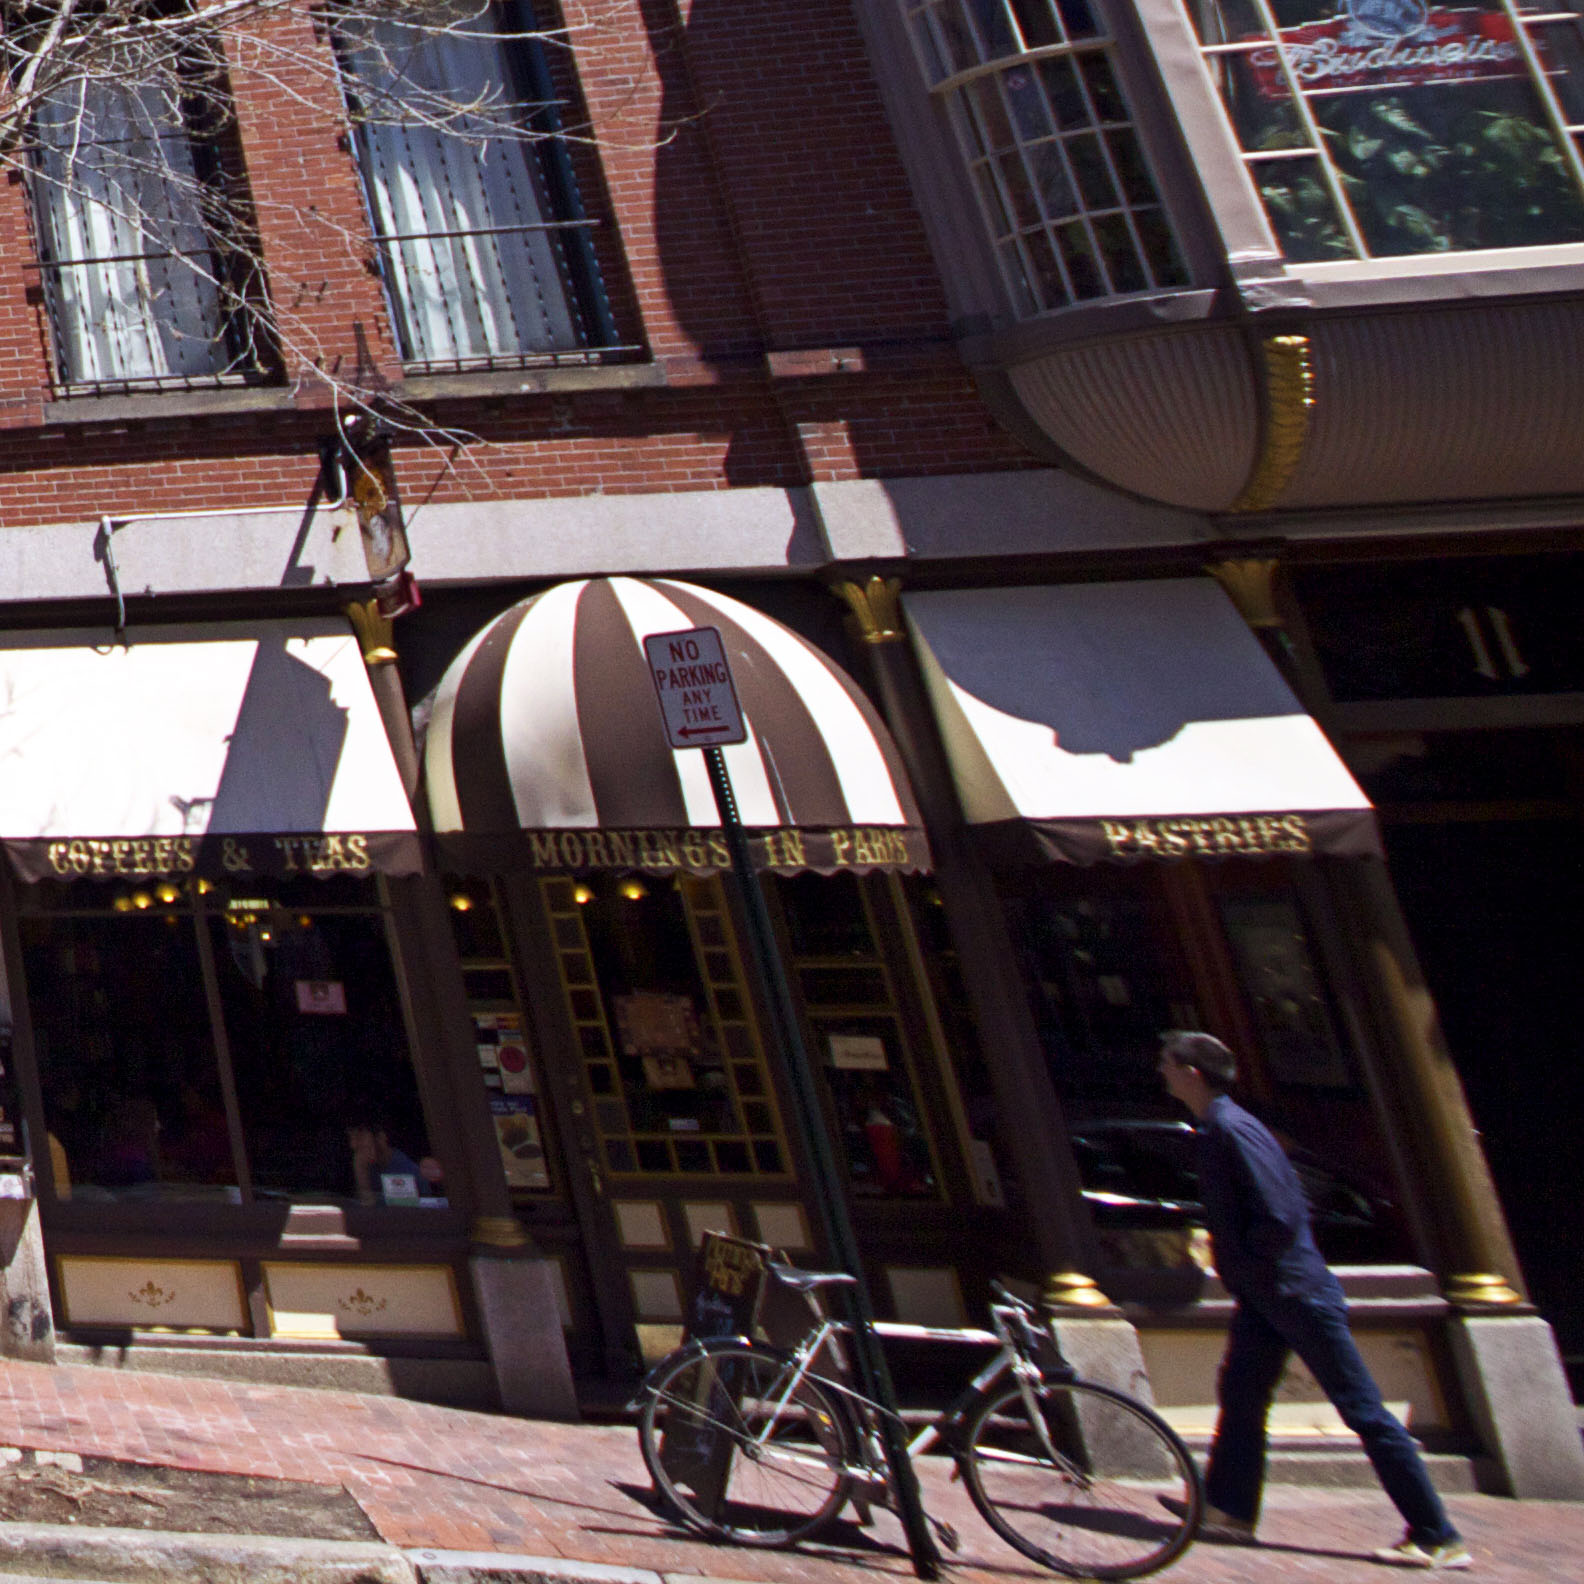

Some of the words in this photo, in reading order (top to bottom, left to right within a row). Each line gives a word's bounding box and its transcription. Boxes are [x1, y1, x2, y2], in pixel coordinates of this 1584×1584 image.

[1252, 33, 1532, 82] Budweise
[668, 639, 700, 663] NO
[1456, 607, 1531, 681] 11
[655, 661, 727, 691] PARKING
[682, 688, 712, 706] ANY
[682, 704, 722, 724] TIME
[47, 839, 196, 875] COFFEES
[221, 838, 254, 872] &
[275, 834, 371, 871] TEAS
[531, 828, 731, 868] MORNINGS
[764, 829, 806, 867] IN
[831, 828, 909, 866] PARIS
[1100, 814, 1312, 856] PASTRIES
